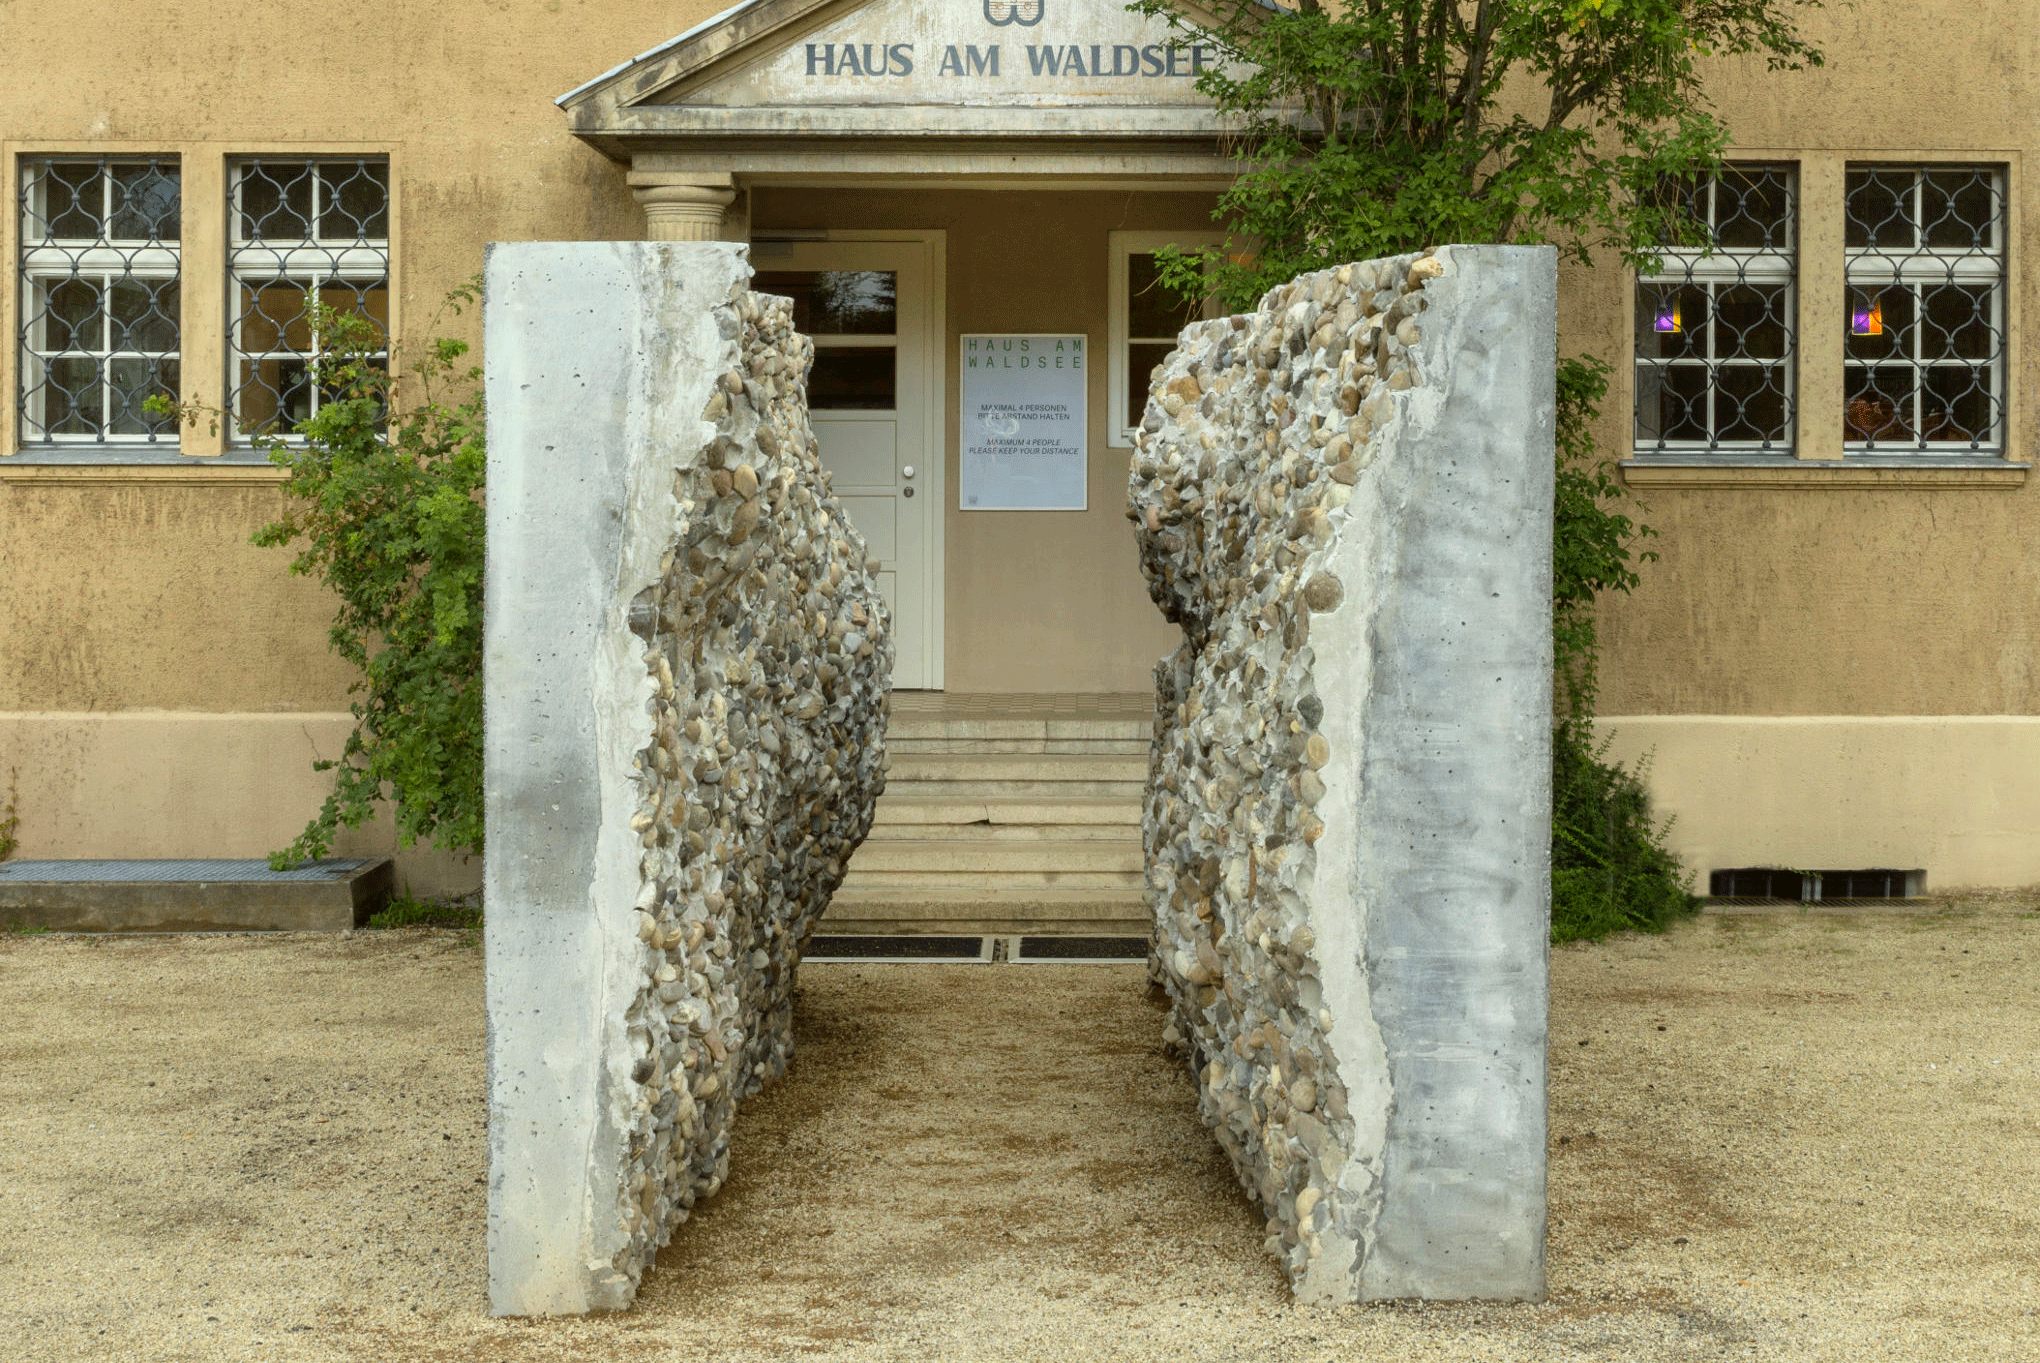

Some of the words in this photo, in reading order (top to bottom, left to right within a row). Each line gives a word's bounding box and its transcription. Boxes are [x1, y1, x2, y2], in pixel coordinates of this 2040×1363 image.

[805, 44, 914, 77] HAUS
[938, 44, 1000, 77] AM
[968, 339, 1030, 352] HAUS
[1055, 339, 1082, 352] AM
[968, 356, 1081, 369] WALDSEE
[980, 404, 1016, 412] MAXIMAL
[1025, 404, 1067, 412] PERSONEN
[1039, 412, 1070, 420] HALTEN
[986, 438, 1025, 446] MAXIMUM
[1032, 438, 1061, 446] PEOPLE
[1041, 447, 1080, 455] DISTANCE
